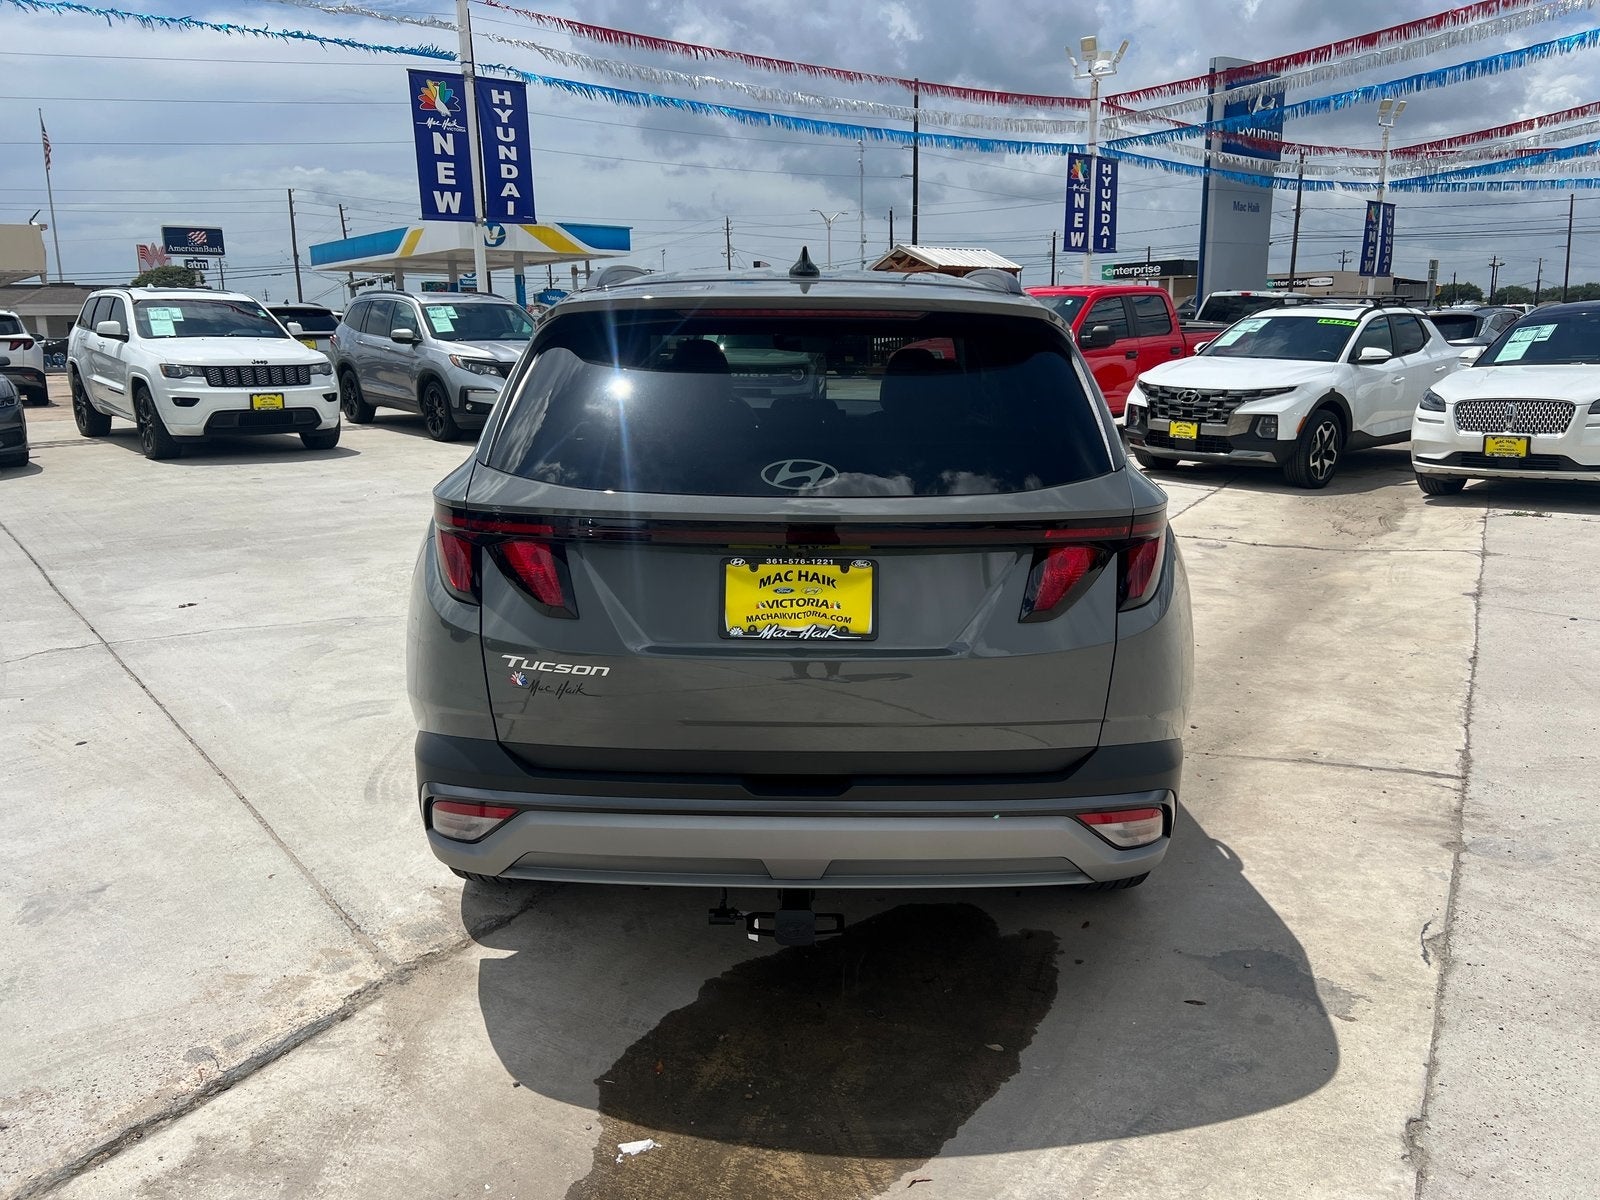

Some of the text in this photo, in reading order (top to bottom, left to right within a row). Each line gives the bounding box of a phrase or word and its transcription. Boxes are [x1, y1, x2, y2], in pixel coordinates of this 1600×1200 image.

[490, 89, 521, 216] HYUNDAI
[432, 131, 462, 214] NEW
[1100, 163, 1112, 249] HYUNDAI
[1070, 192, 1085, 247] NEW
[168, 244, 223, 253] AmericanBank
[1383, 207, 1393, 273] HYUNDAI
[1364, 230, 1376, 272] NEW
[187, 259, 208, 269] atm
[1104, 263, 1161, 276] enterprise
[1267, 279, 1308, 287] enterrise
[759, 570, 837, 589] MAC HAIK
[766, 598, 830, 610] VICTORIA
[746, 610, 852, 624] MACHAIKVICTORIA.COM
[755, 624, 852, 640] Mac Haik
[526, 680, 594, 699] Mac Haik
